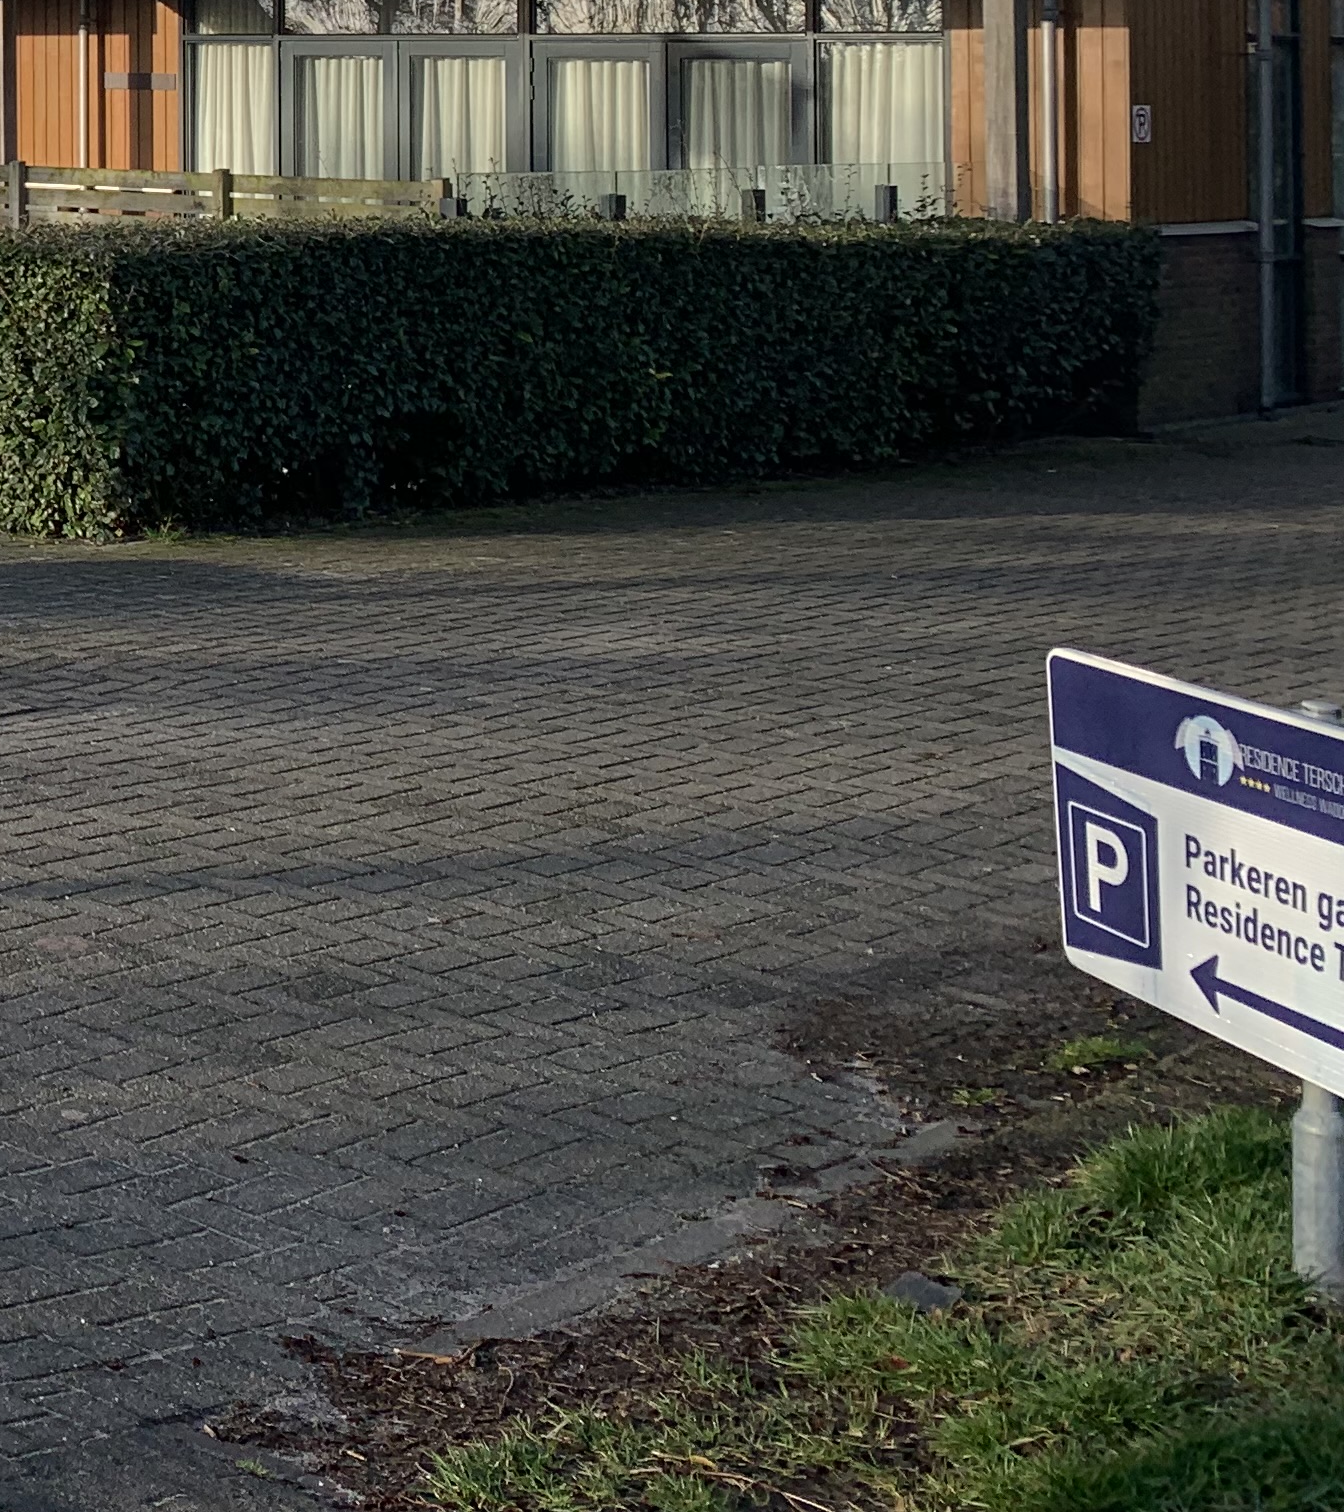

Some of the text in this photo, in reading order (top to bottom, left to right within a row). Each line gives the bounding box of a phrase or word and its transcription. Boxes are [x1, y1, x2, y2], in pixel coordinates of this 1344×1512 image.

[1238, 743, 1301, 782] RESIDENCE
[1086, 821, 1128, 913] P
[1185, 834, 1307, 913] Parkeren
[1187, 884, 1326, 972] Residence
